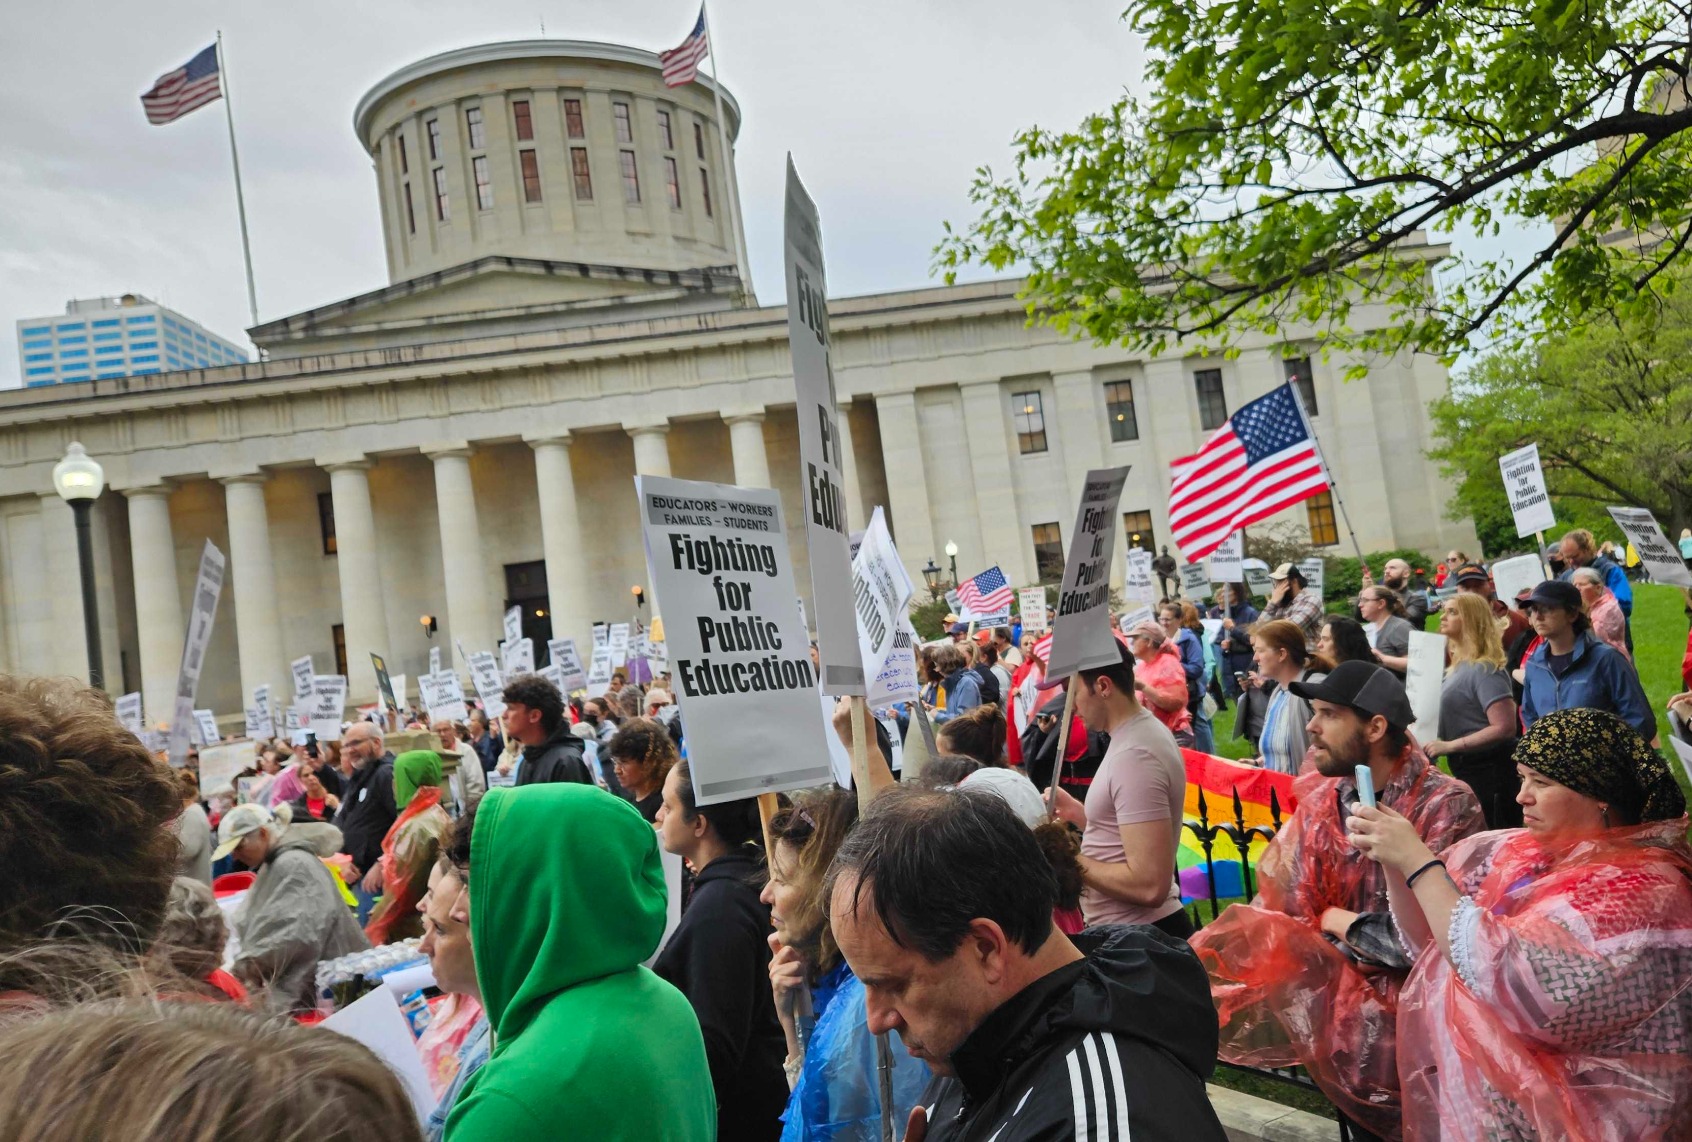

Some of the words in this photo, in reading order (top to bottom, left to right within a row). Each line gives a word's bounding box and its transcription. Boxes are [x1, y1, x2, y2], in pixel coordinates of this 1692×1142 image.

[1506, 462, 1536, 480] Fighting
[1518, 476, 1528, 488] for
[1515, 485, 1538, 500] Public
[652, 497, 718, 512] EDUCATORS
[728, 502, 772, 516] WORKERS
[1512, 492, 1546, 512] Education
[664, 514, 712, 526] FAMILIES
[724, 518, 768, 532] STUDENTS
[1621, 522, 1657, 536] Fighting
[1638, 534, 1652, 544] for
[1638, 542, 1668, 554] Public
[668, 533, 778, 578] Fighting
[1639, 550, 1682, 564] Education
[712, 576, 752, 612] for
[696, 616, 782, 653] Public
[678, 654, 814, 697] Education
